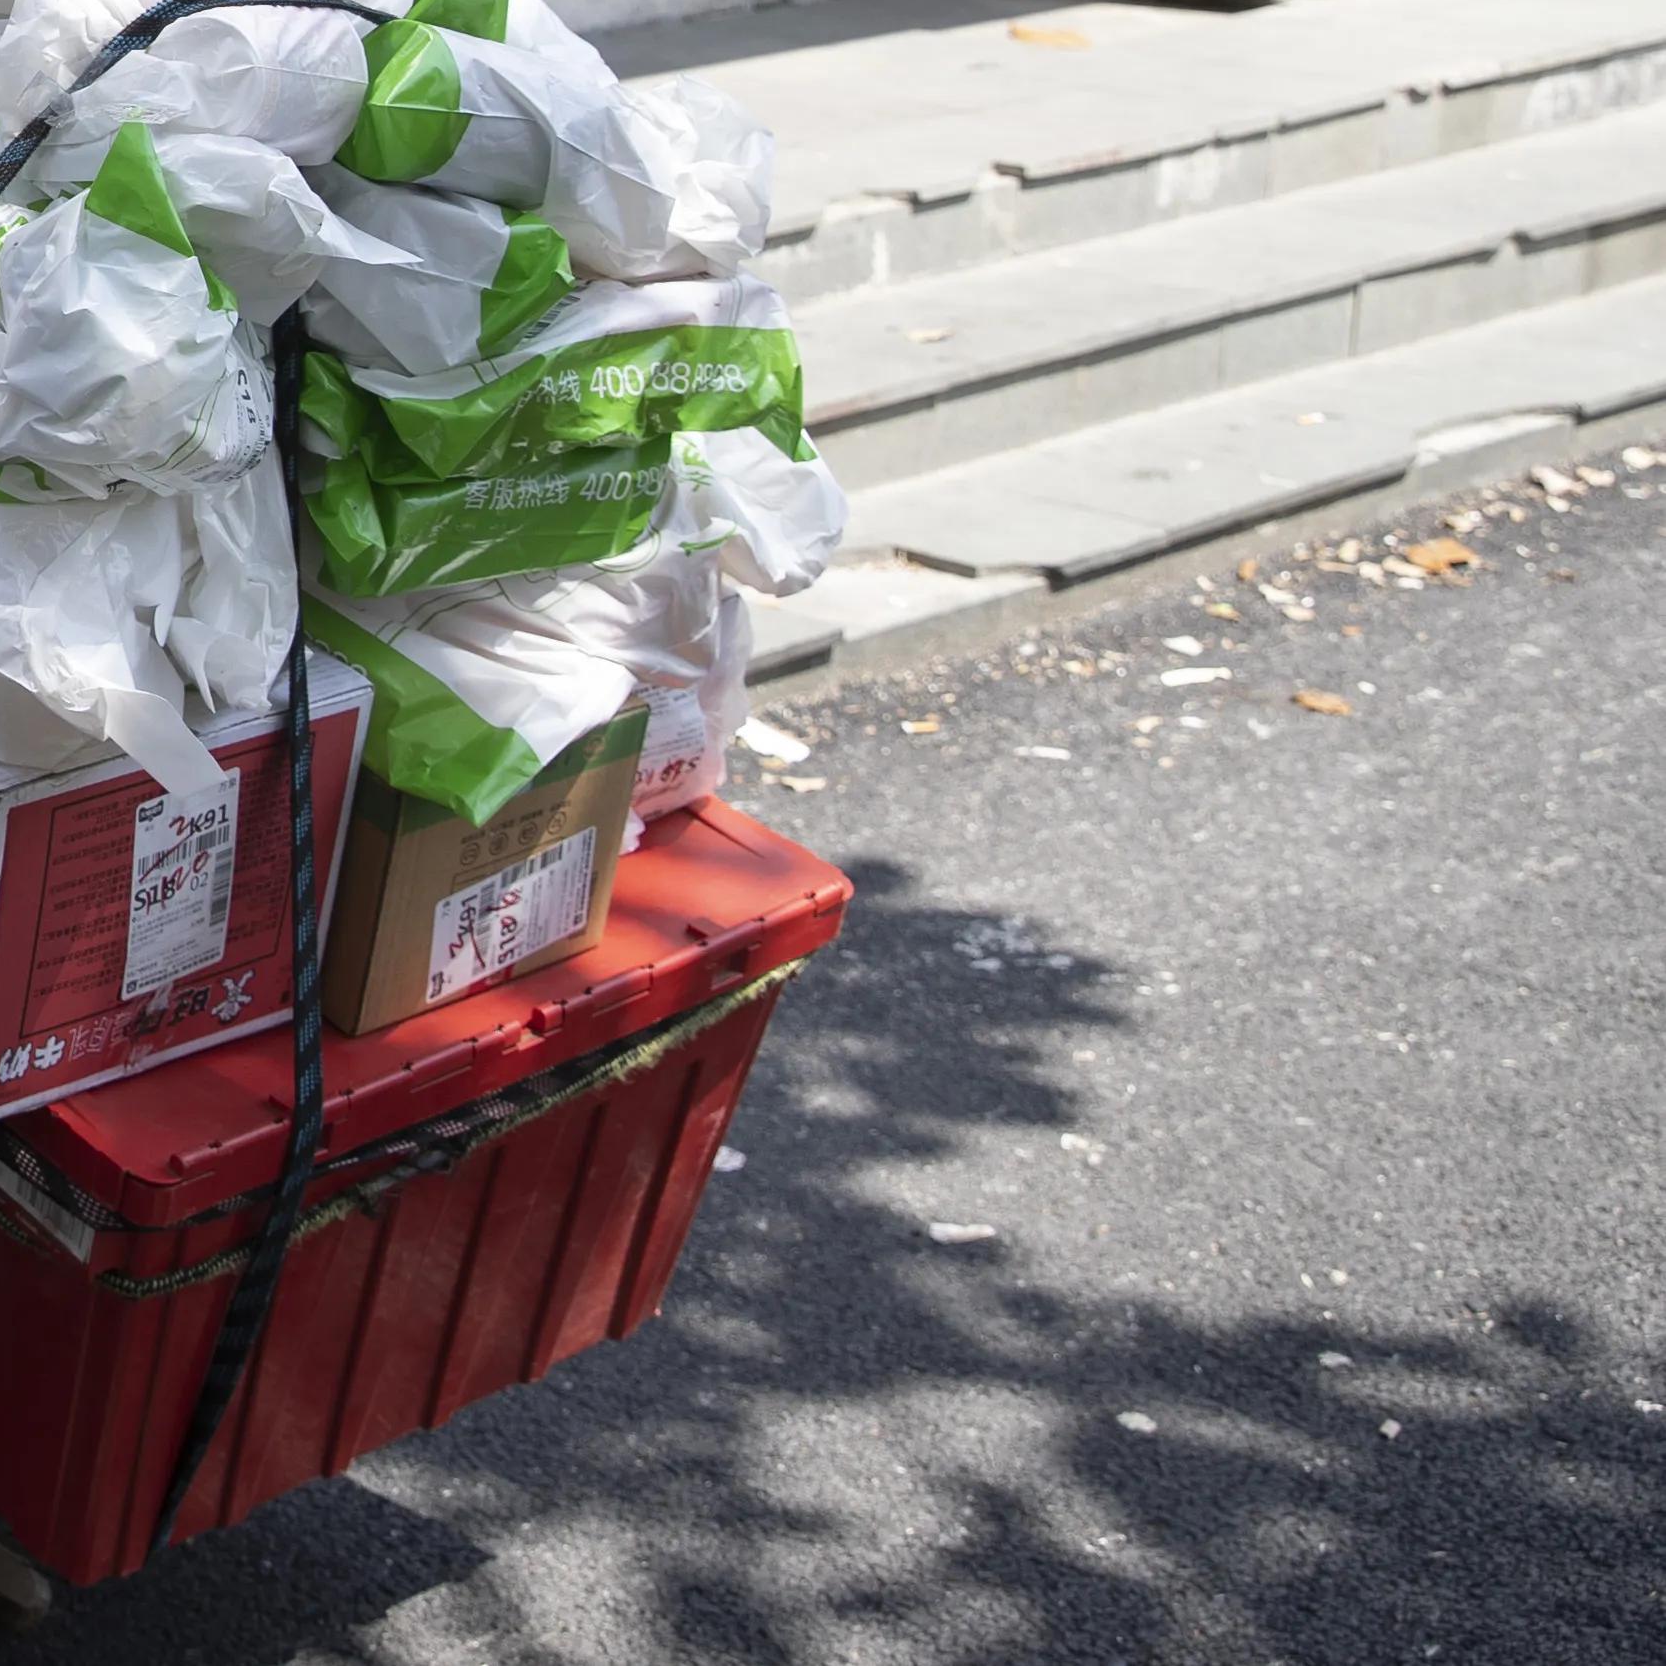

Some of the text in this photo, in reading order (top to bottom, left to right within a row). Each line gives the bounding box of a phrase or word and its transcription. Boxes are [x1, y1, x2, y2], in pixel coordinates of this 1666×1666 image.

[589, 364, 646, 399] 400
[464, 476, 571, 511] 客服热线
[580, 471, 634, 502] 400
[188, 803, 230, 836] K91
